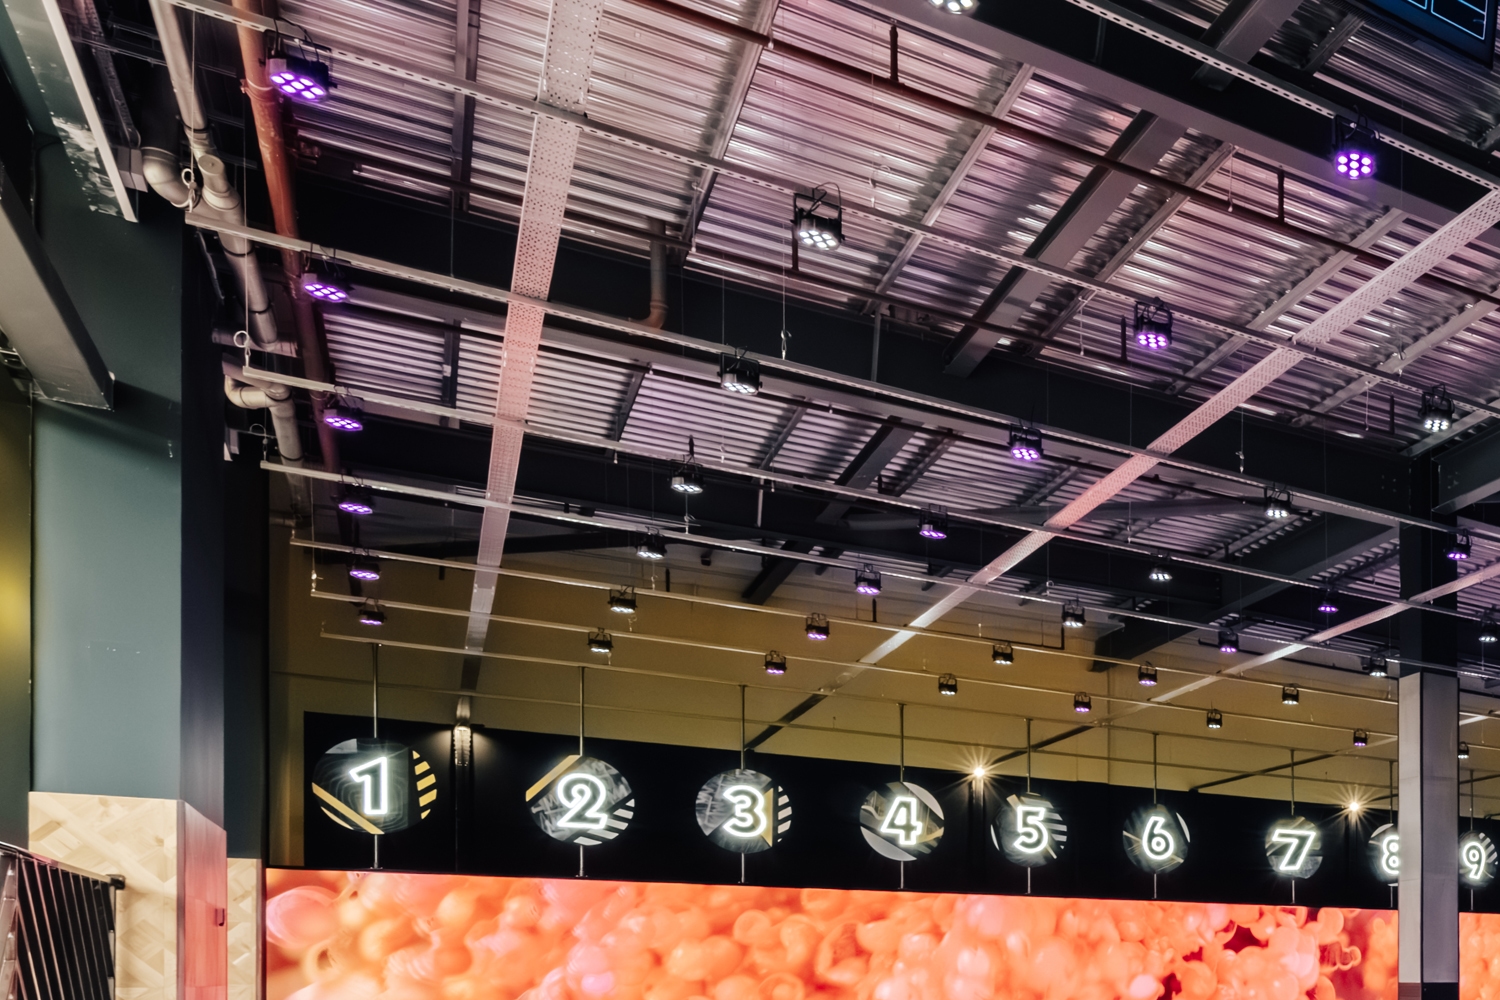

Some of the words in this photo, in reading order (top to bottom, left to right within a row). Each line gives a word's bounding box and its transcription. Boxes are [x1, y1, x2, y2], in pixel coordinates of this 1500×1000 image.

[349, 755, 389, 816] 1
[556, 772, 608, 830] 2
[722, 784, 767, 838] 3
[880, 795, 923, 846] 4
[1014, 806, 1049, 853] 5
[1142, 816, 1175, 860] 6
[1272, 829, 1317, 871] 7
[1382, 834, 1399, 875] 8
[1462, 841, 1486, 880] 9
